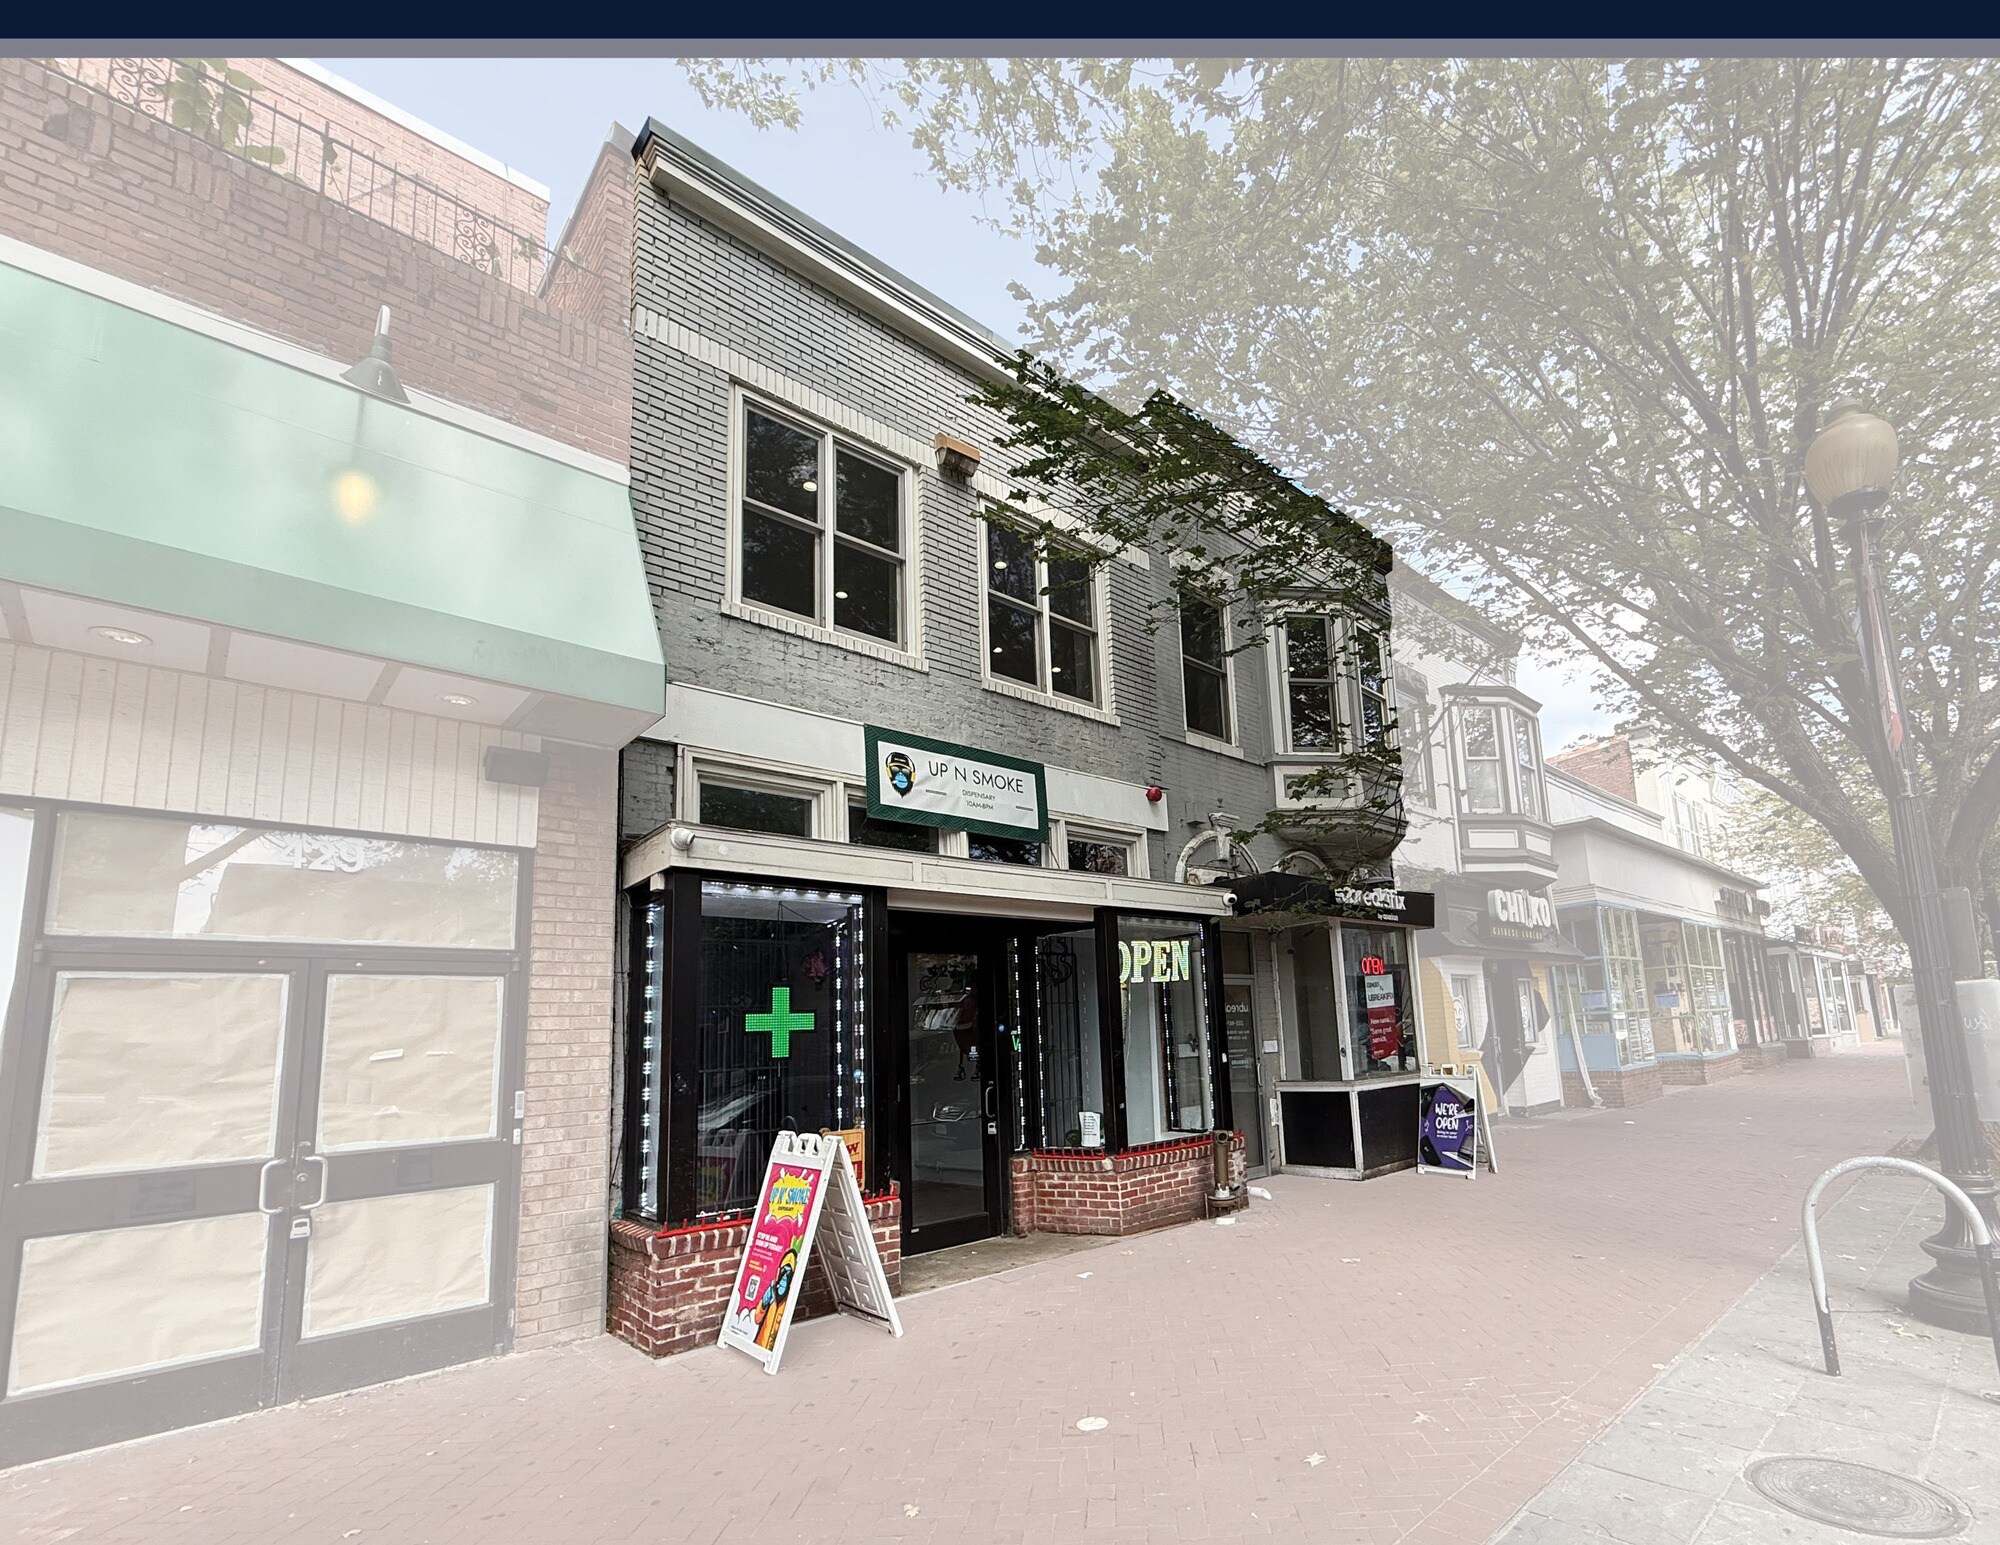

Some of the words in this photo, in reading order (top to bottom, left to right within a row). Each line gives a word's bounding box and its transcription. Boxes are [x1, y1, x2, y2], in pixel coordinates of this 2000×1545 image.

[928, 760, 949, 777] UP
[954, 765, 967, 782] N
[973, 769, 1024, 794] SMOKE
[962, 789, 996, 801] DISPENSARY
[279, 835, 366, 873] 429
[1361, 957, 1384, 974] OPEN
[1435, 1102, 1460, 1116] WE'RE
[1435, 1117, 1459, 1130] OPEN
